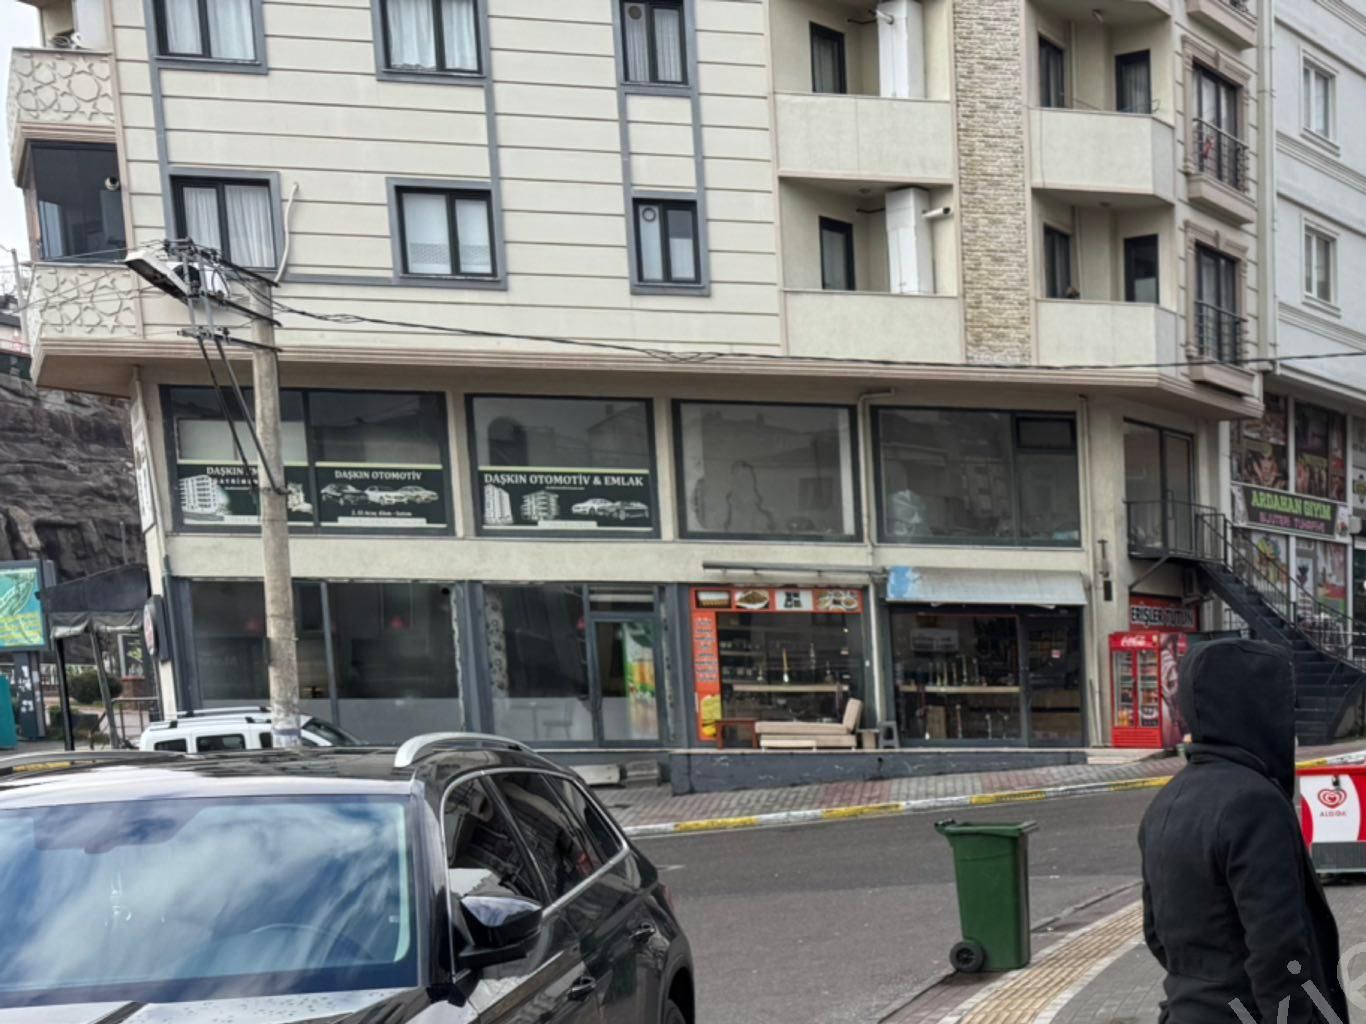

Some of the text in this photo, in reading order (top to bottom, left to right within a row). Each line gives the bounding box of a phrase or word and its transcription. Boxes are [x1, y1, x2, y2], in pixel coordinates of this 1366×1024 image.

[484, 473, 527, 486] DAŞKIN
[529, 474, 590, 486] OTOMOTİV
[604, 476, 644, 487] EMLAK
